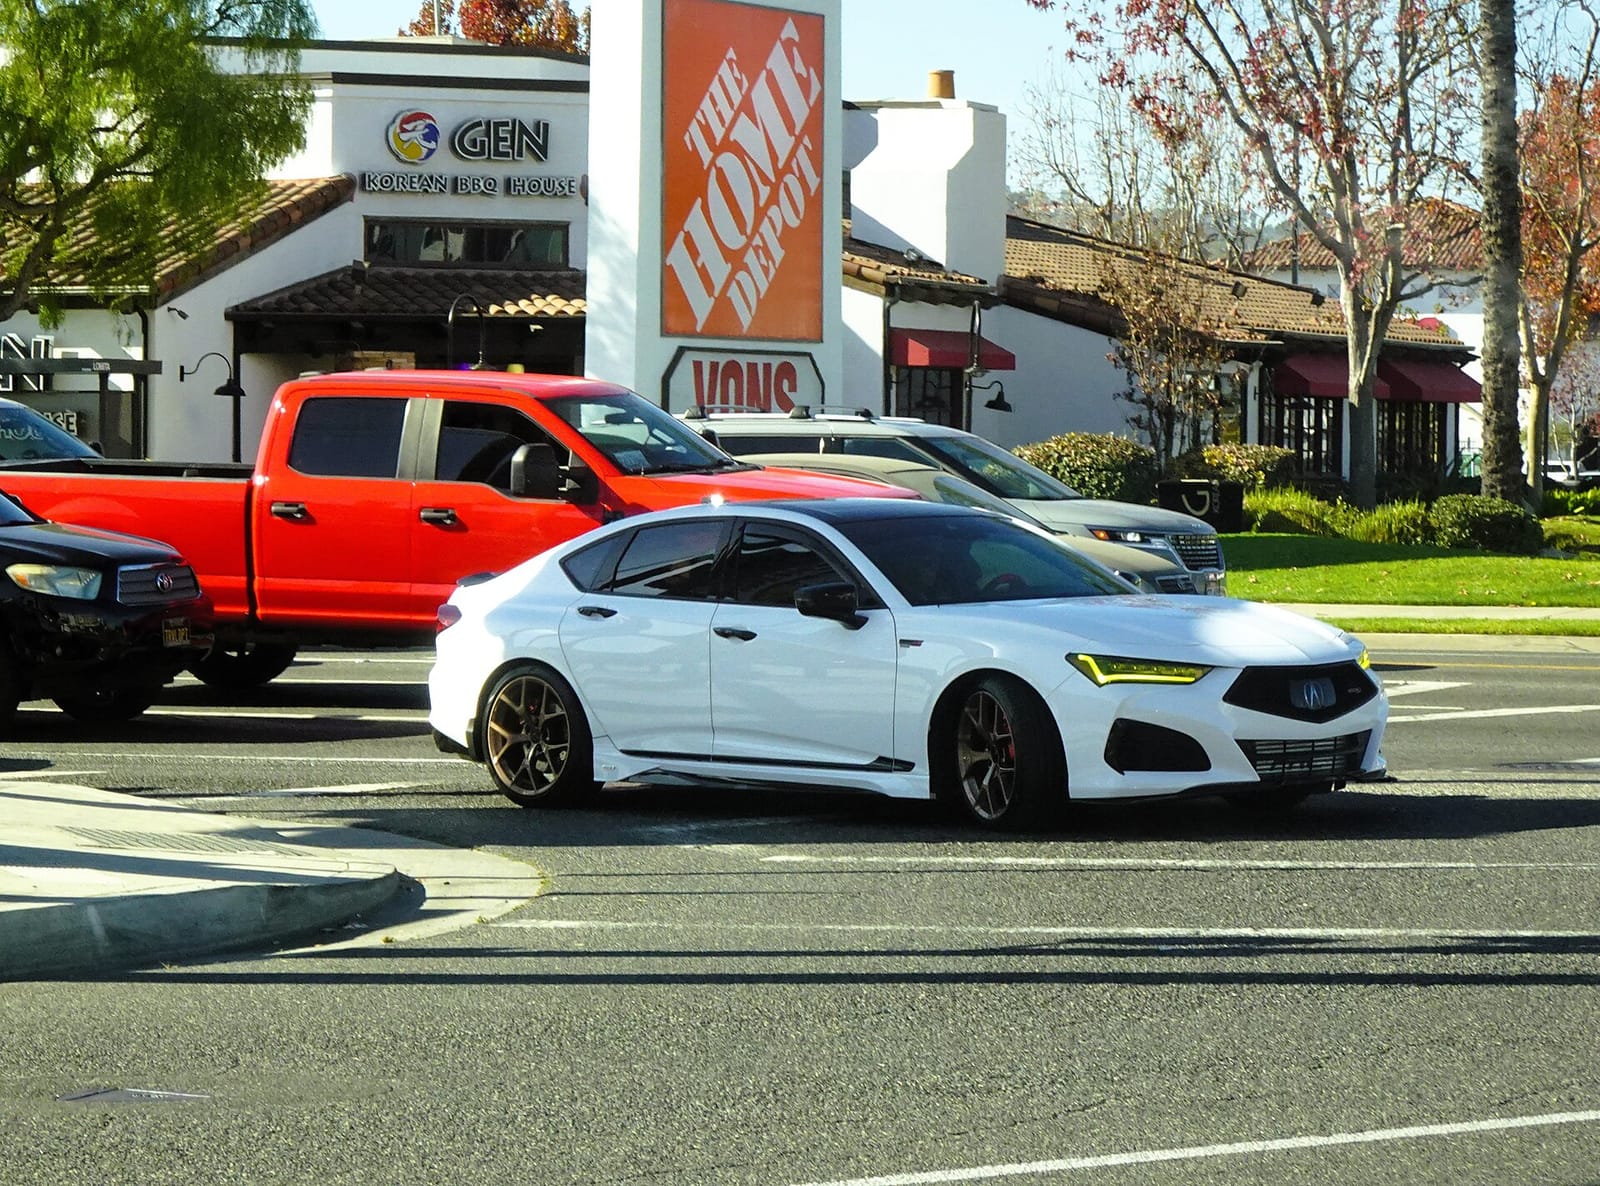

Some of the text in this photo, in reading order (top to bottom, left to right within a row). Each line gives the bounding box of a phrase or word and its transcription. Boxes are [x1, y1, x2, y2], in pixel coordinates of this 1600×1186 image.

[453, 118, 550, 162] GEN
[683, 46, 750, 170] THE
[364, 172, 577, 196] KOREAN BBQ HOUSE
[665, 16, 822, 334] HOME
[726, 134, 821, 334] DEPOT
[692, 359, 797, 414] VONS
